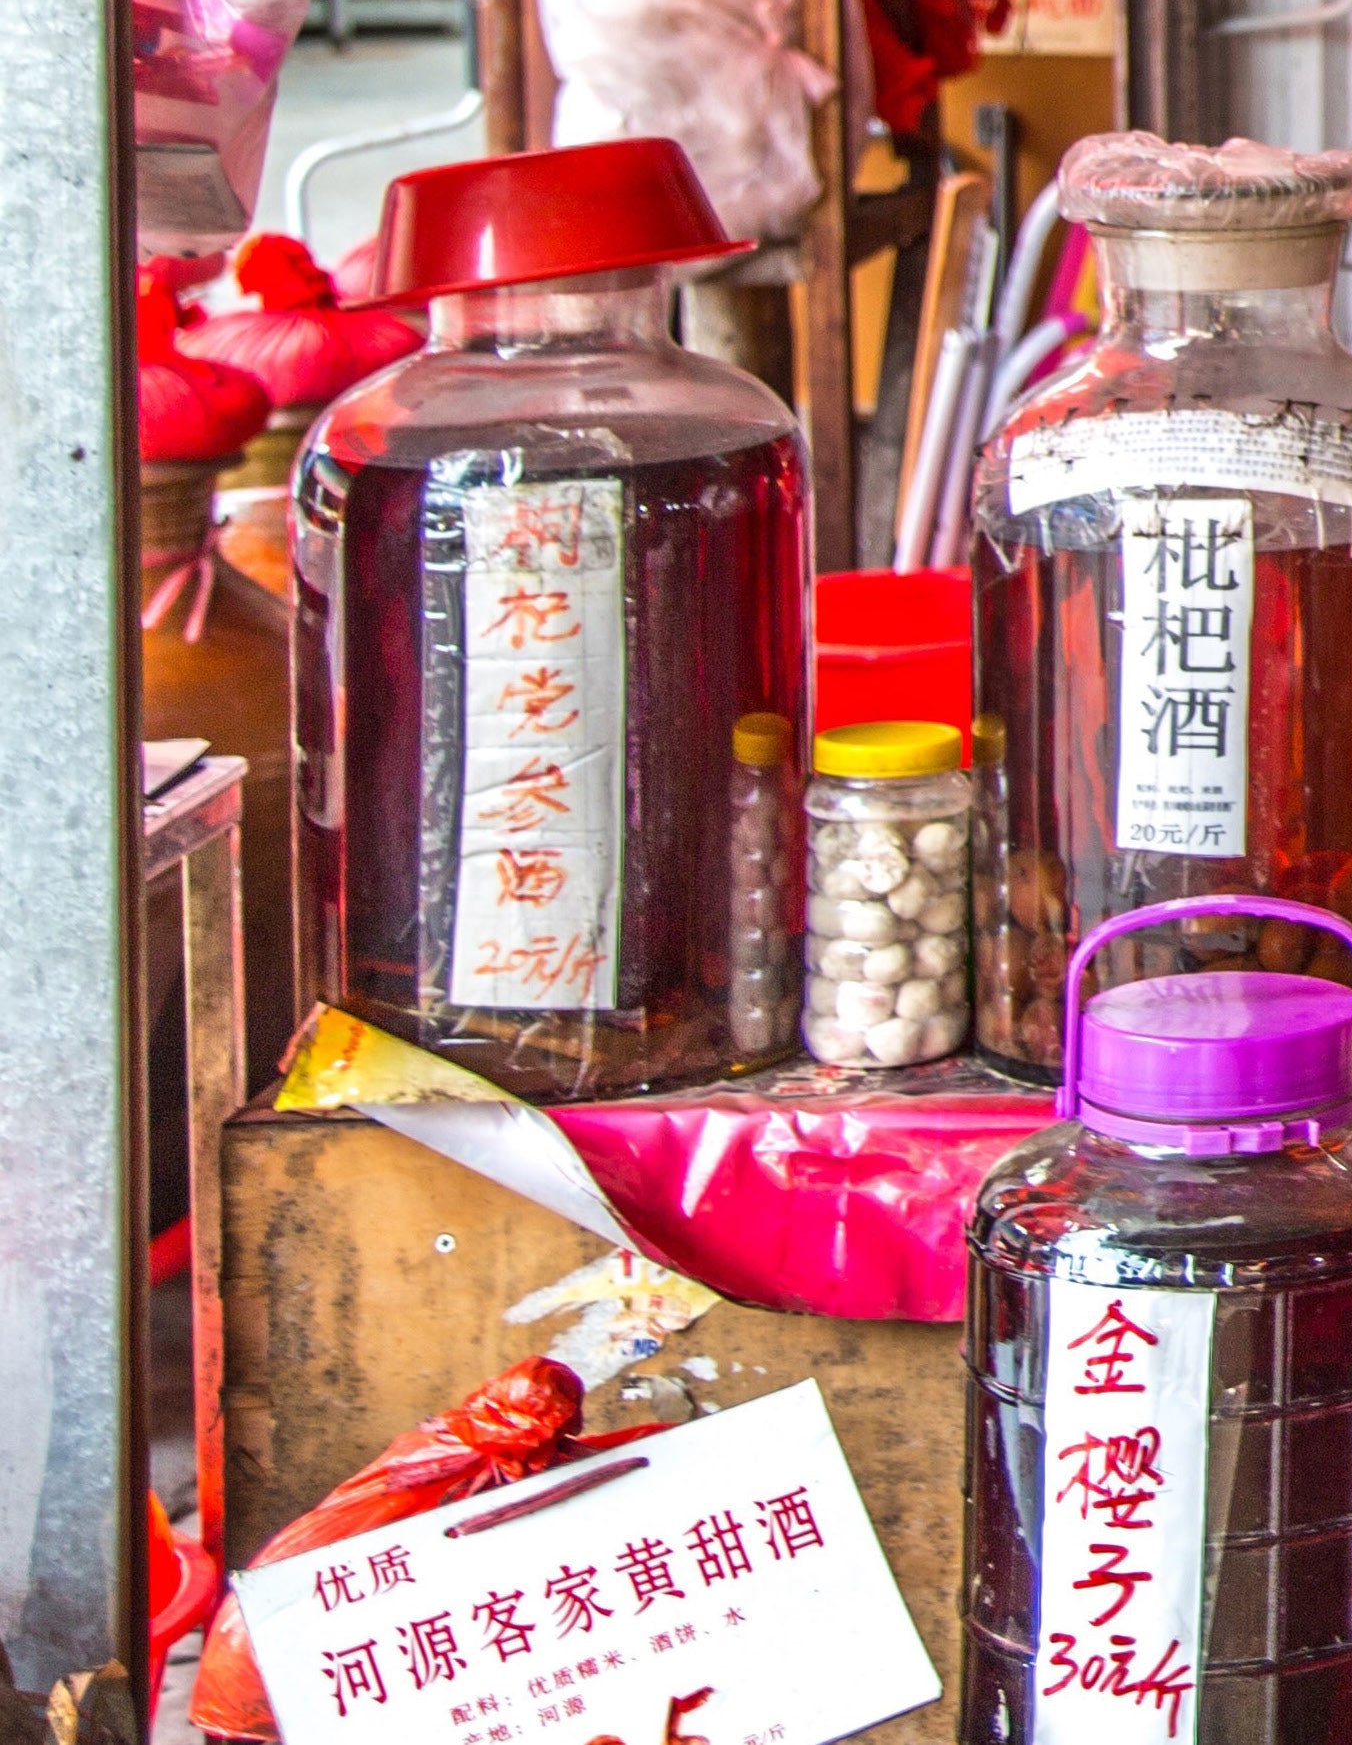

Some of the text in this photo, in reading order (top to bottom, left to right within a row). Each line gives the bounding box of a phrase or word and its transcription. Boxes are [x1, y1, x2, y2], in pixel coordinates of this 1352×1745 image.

[1141, 517, 1241, 759] 枇杷酒
[1129, 822, 1228, 847] 20元/斤
[312, 1543, 418, 1614] 优质
[1055, 1299, 1165, 1627] 金樱子
[320, 1485, 826, 1718] 河源客家黄甜酒
